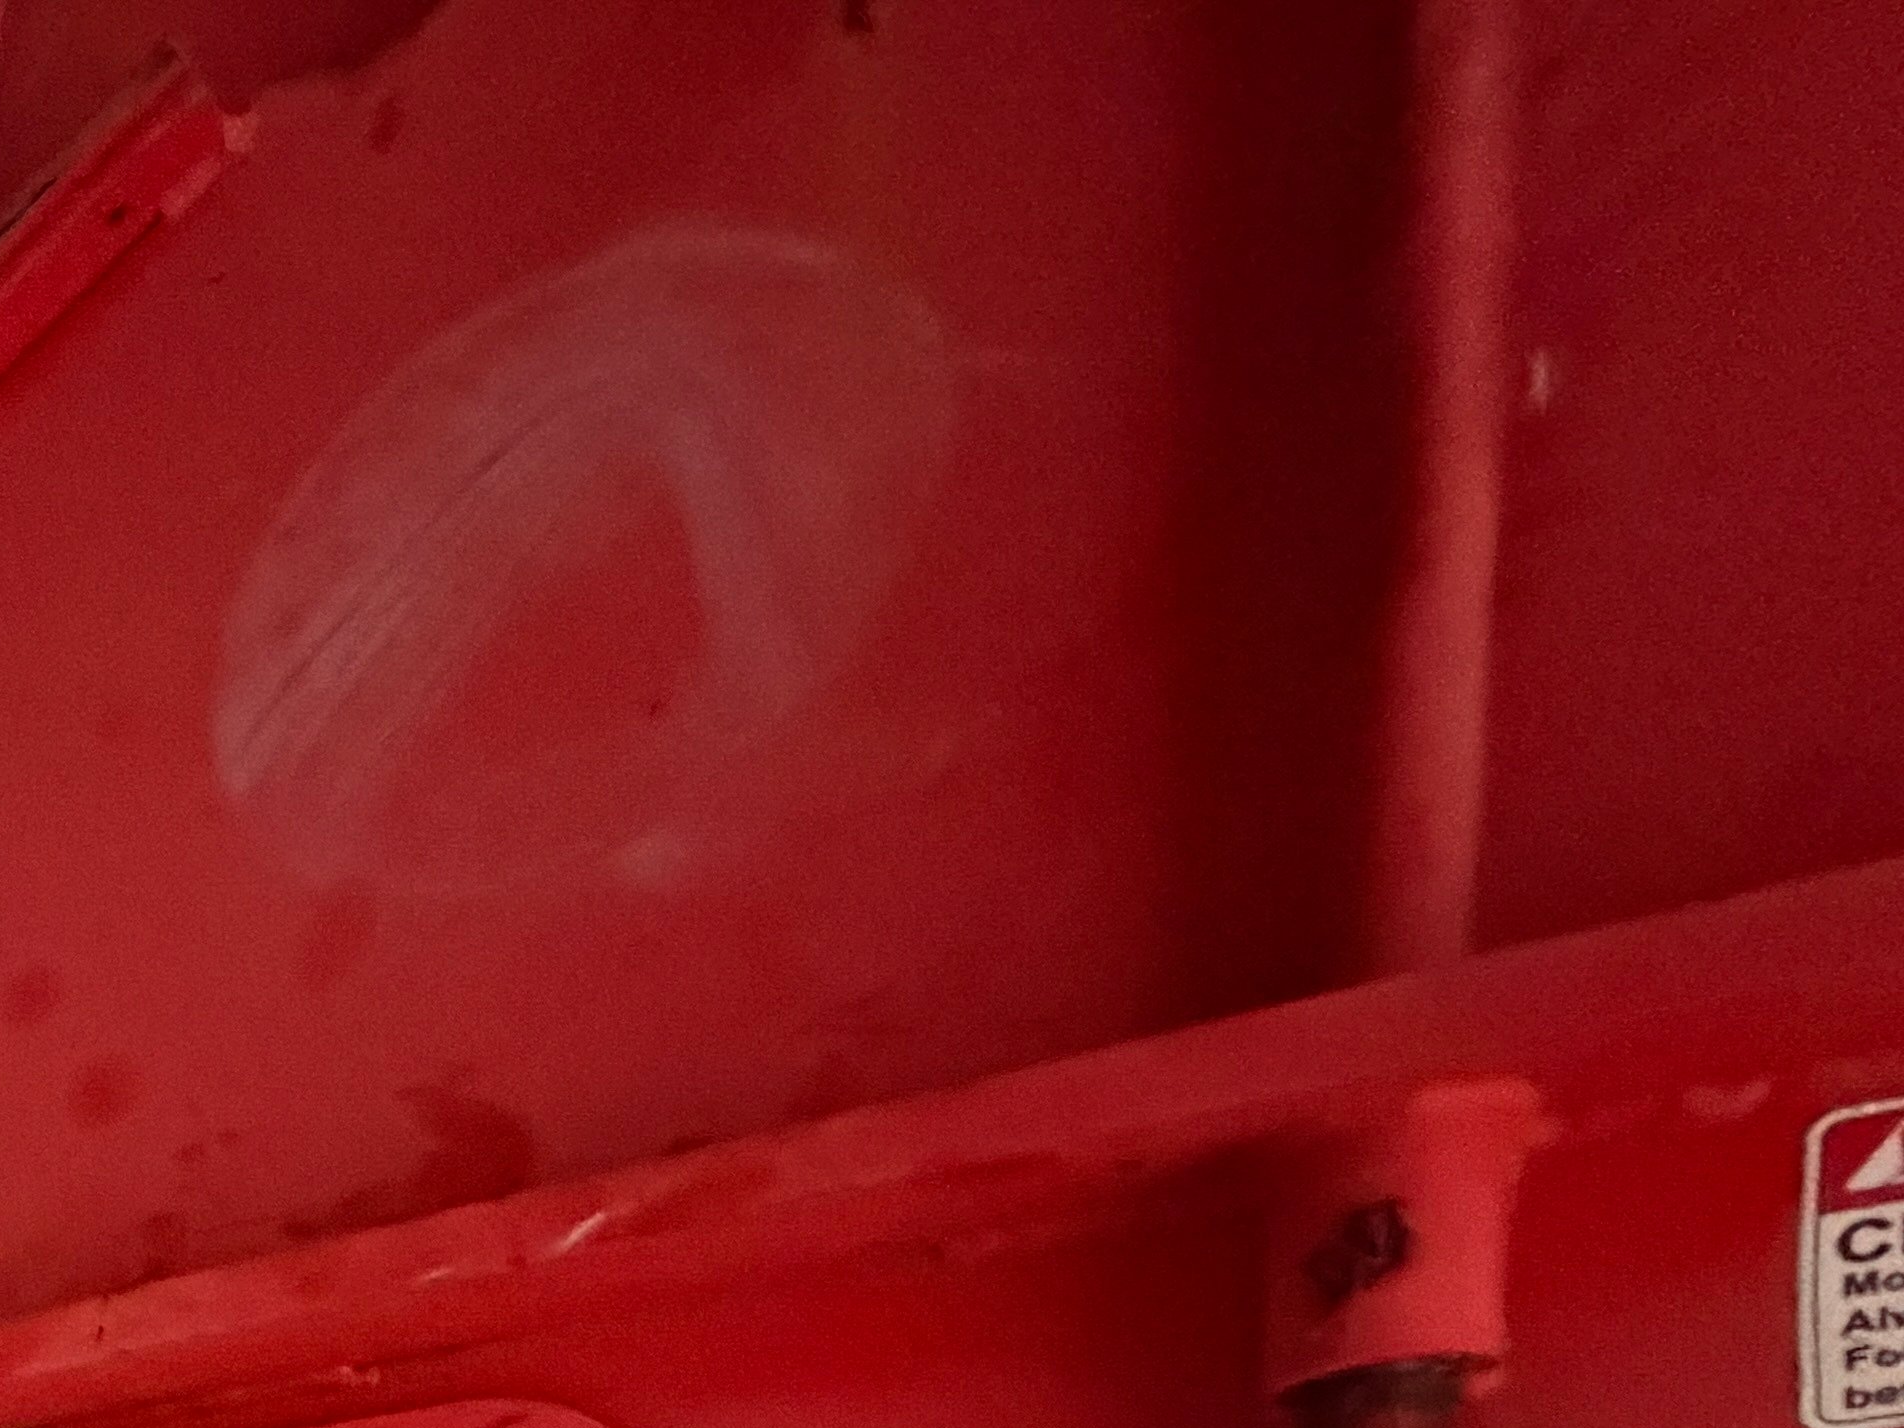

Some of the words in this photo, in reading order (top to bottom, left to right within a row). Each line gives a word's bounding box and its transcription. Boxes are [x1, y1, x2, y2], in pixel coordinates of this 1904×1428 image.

[1837, 1218, 1904, 1263] C
[1845, 1344, 1904, 1371] Fo
[1845, 1384, 1904, 1410] be
